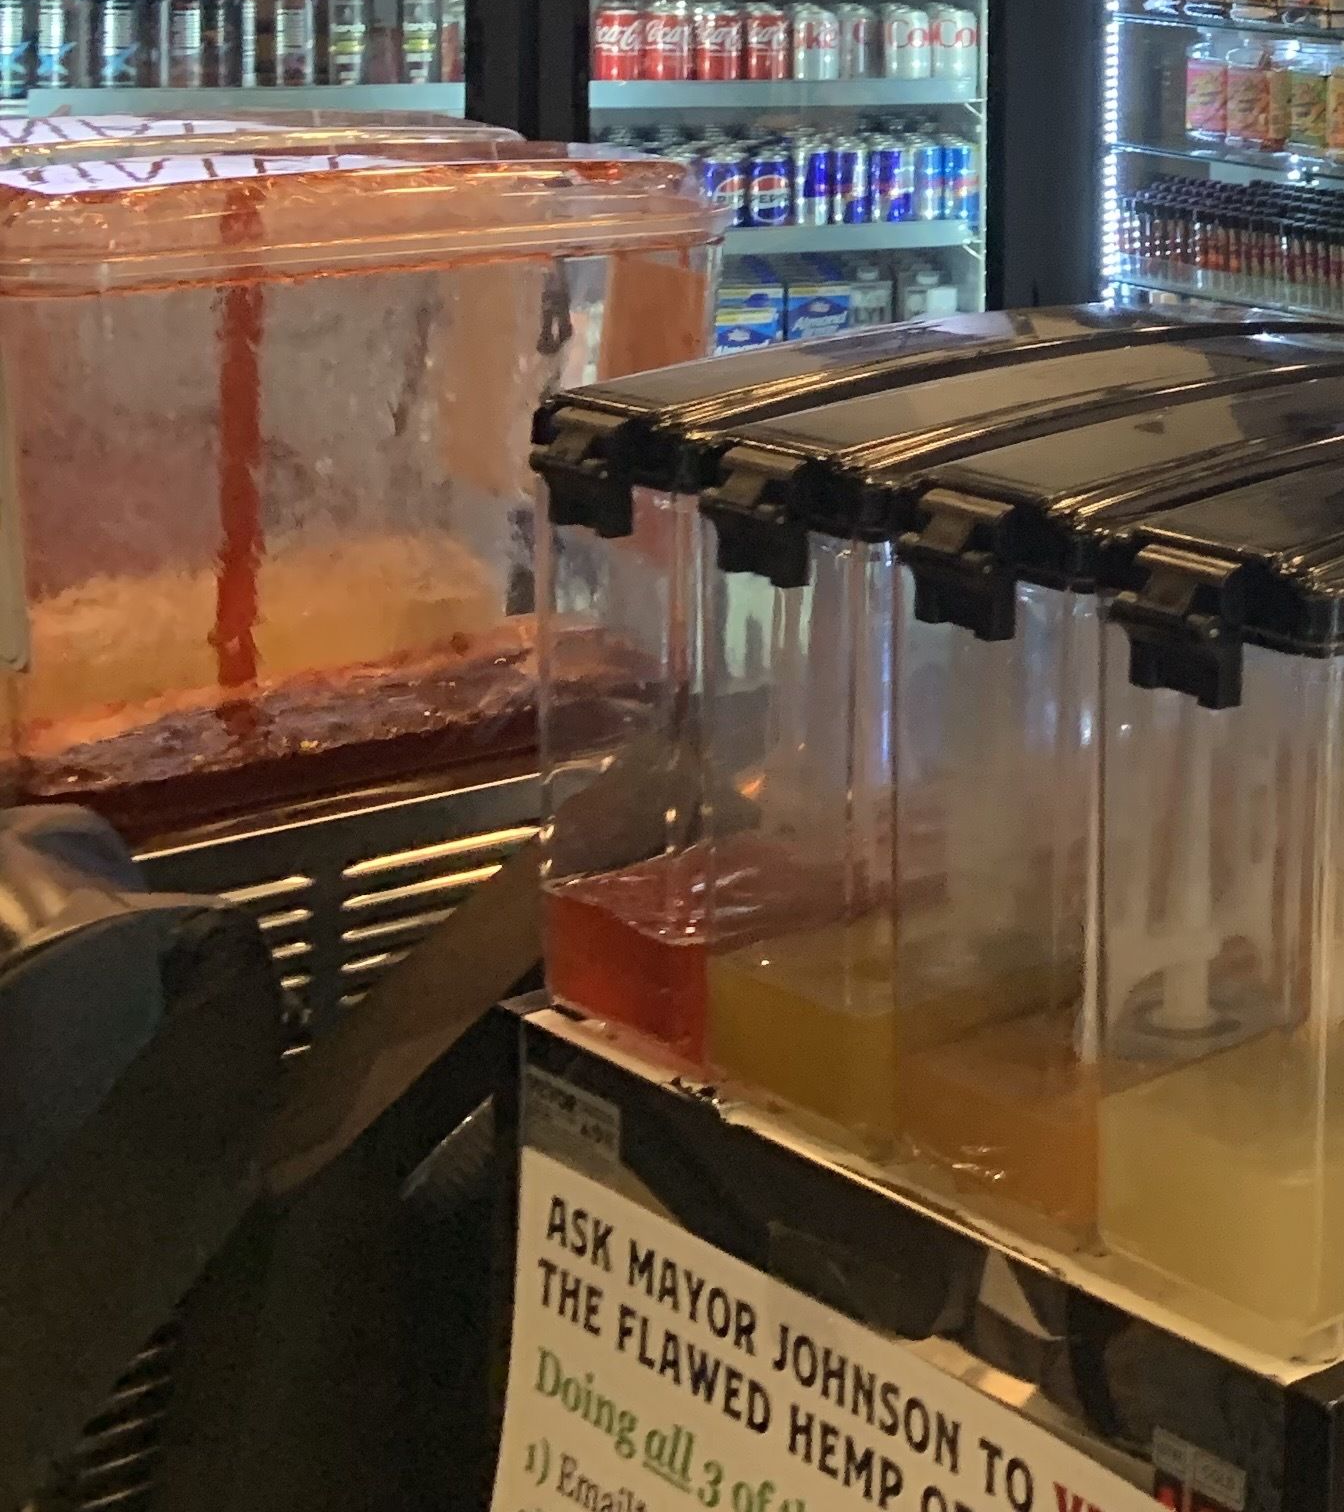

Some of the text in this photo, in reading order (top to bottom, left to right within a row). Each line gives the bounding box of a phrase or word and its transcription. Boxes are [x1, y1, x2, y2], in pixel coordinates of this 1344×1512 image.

[535, 1349, 639, 1460] Doing
[644, 1424, 695, 1491] all
[697, 1458, 723, 1509] 3
[537, 1258, 904, 1510] THE FLAWED HEMP
[546, 1196, 1034, 1512] ASK MAYOR JOHNSON TO
[524, 1438, 550, 1486] 1)
